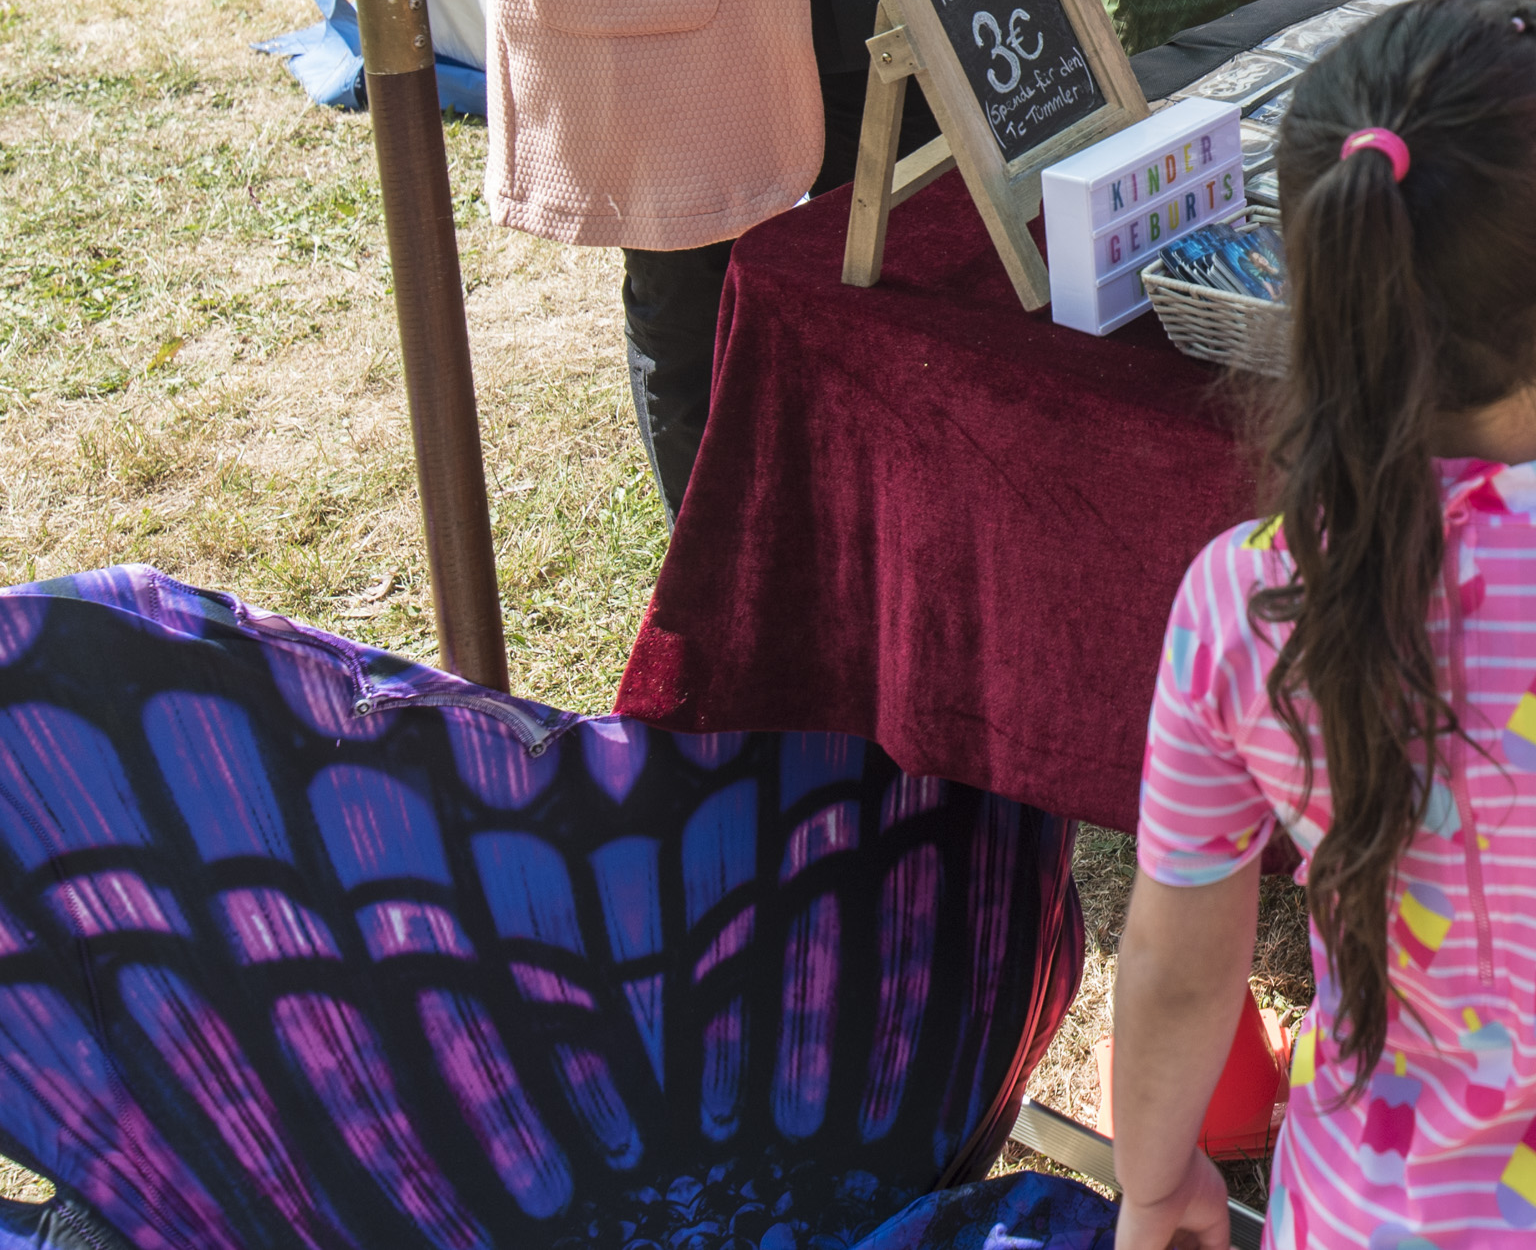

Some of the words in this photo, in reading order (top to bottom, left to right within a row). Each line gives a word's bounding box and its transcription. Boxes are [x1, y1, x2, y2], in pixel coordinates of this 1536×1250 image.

[972, 8, 1044, 94] 3€
[1033, 67, 1054, 94] für
[1111, 135, 1213, 212] KINDER
[1110, 173, 1234, 264] GEBURTS
